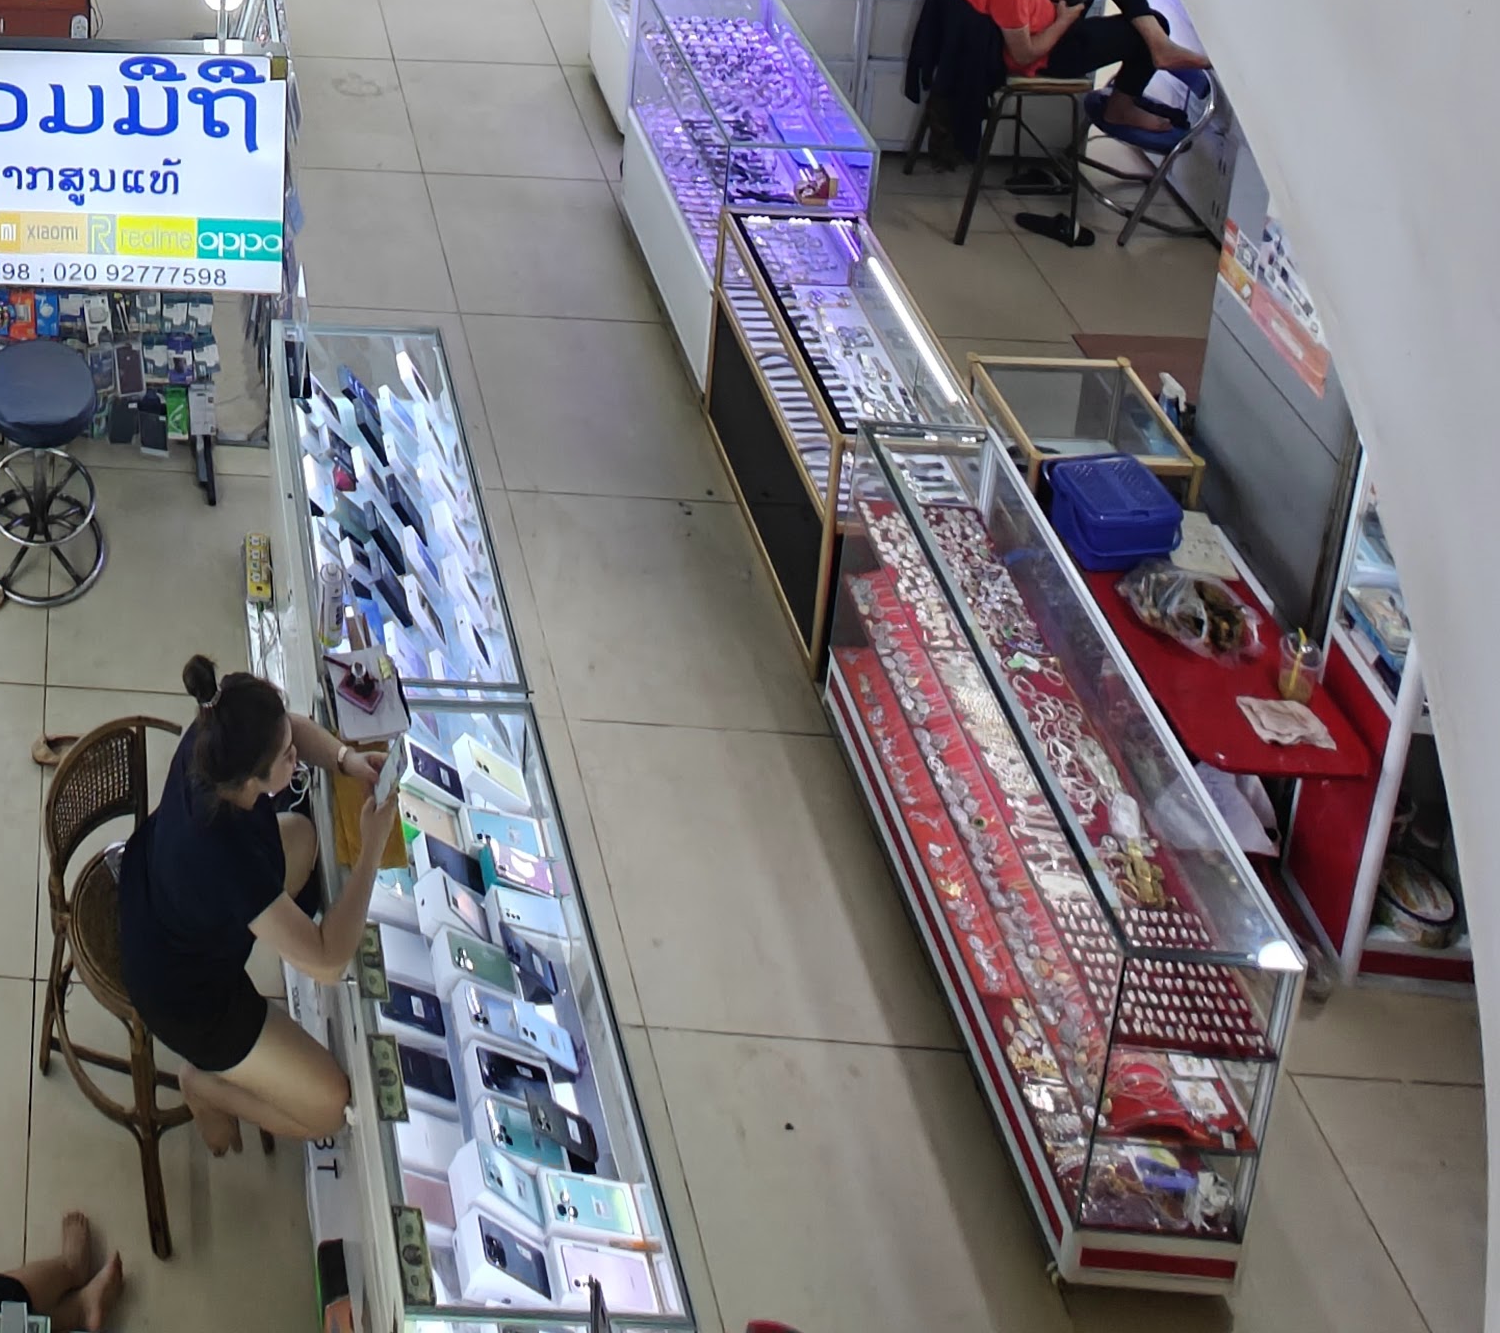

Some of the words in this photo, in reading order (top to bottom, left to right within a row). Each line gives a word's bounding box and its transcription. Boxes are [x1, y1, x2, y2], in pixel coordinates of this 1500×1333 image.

[26, 224, 79, 244] xiaomi
[119, 224, 192, 253] realme
[198, 230, 284, 258] oppo
[52, 265, 98, 284] 020
[104, 266, 228, 287] 92777598
